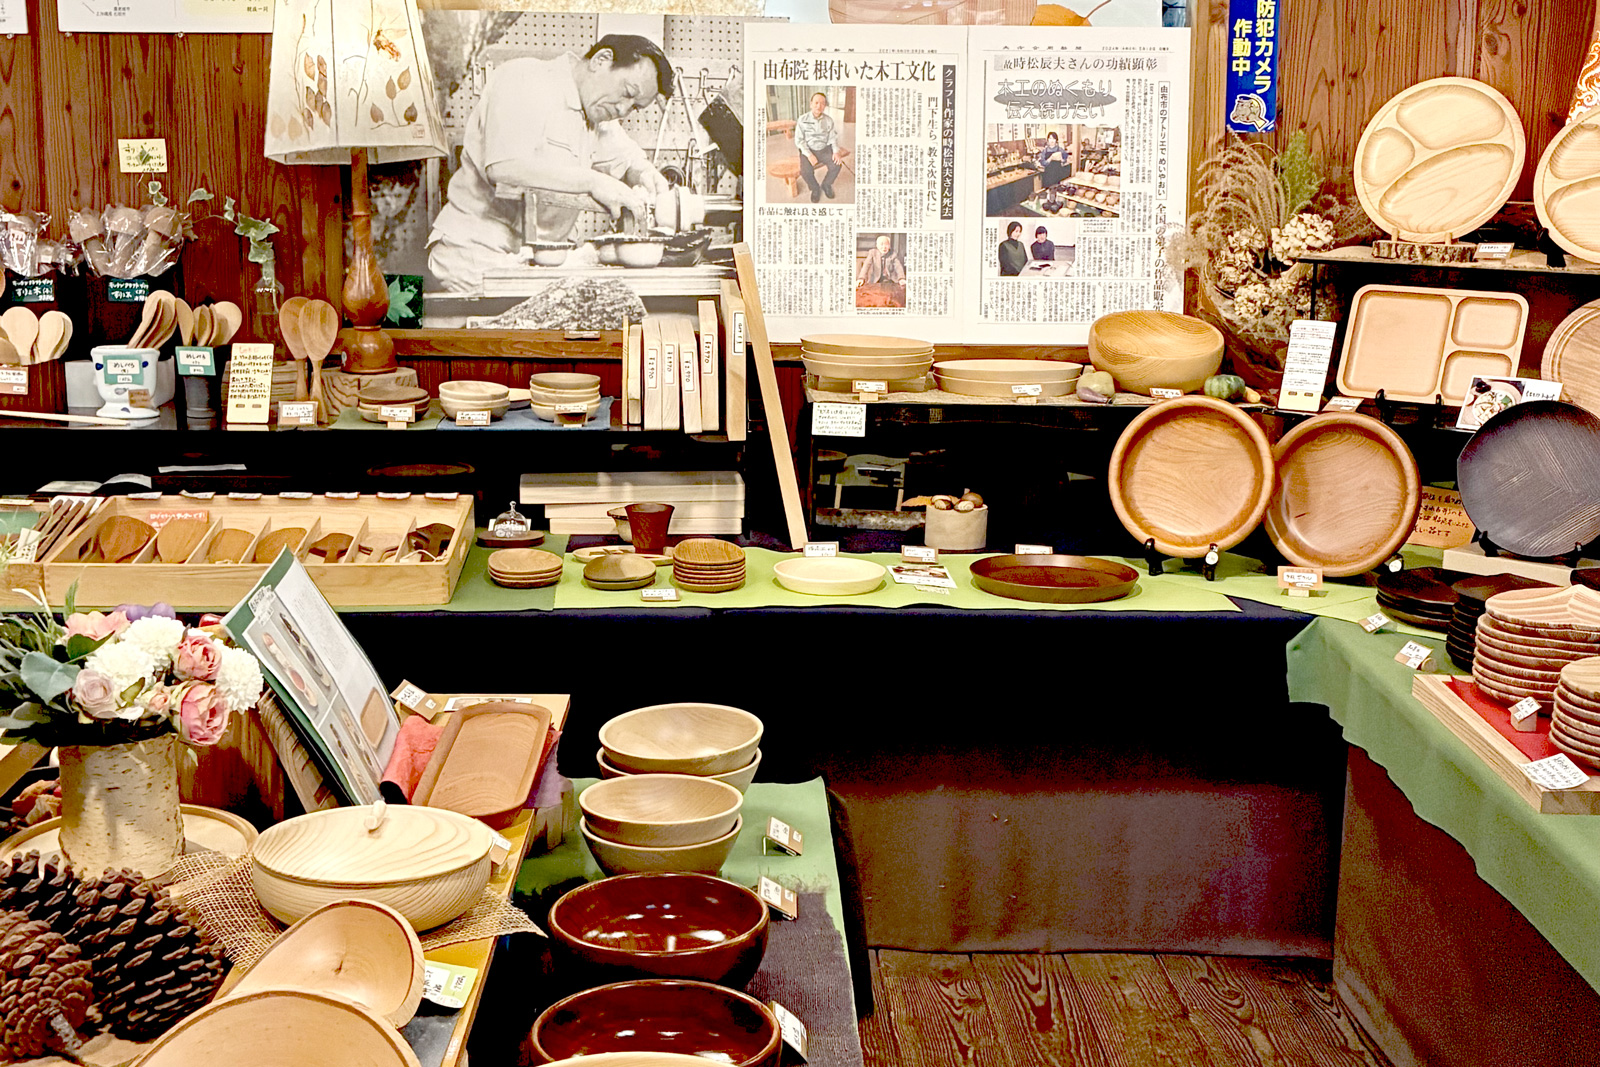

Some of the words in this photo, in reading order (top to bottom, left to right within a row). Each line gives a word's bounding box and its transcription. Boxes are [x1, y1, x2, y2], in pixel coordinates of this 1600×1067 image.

[1232, 19, 1253, 77] 作動中
[1254, 0, 1276, 94] 防犯カメラ
[763, 59, 809, 81] 由布院
[812, 59, 936, 82] 根付いた木工文化
[1003, 56, 1158, 70] 故時松辰夫さんの功績顕彰
[997, 79, 1113, 97] 木工のぬくもり
[1006, 101, 1105, 119] 伝え続けたい
[1159, 85, 1168, 156] 由布市のアトリエで
[941, 68, 954, 217] クラフト作家の時松辰夫さん死去
[758, 206, 844, 217] 作品に触れ良さ感じて
